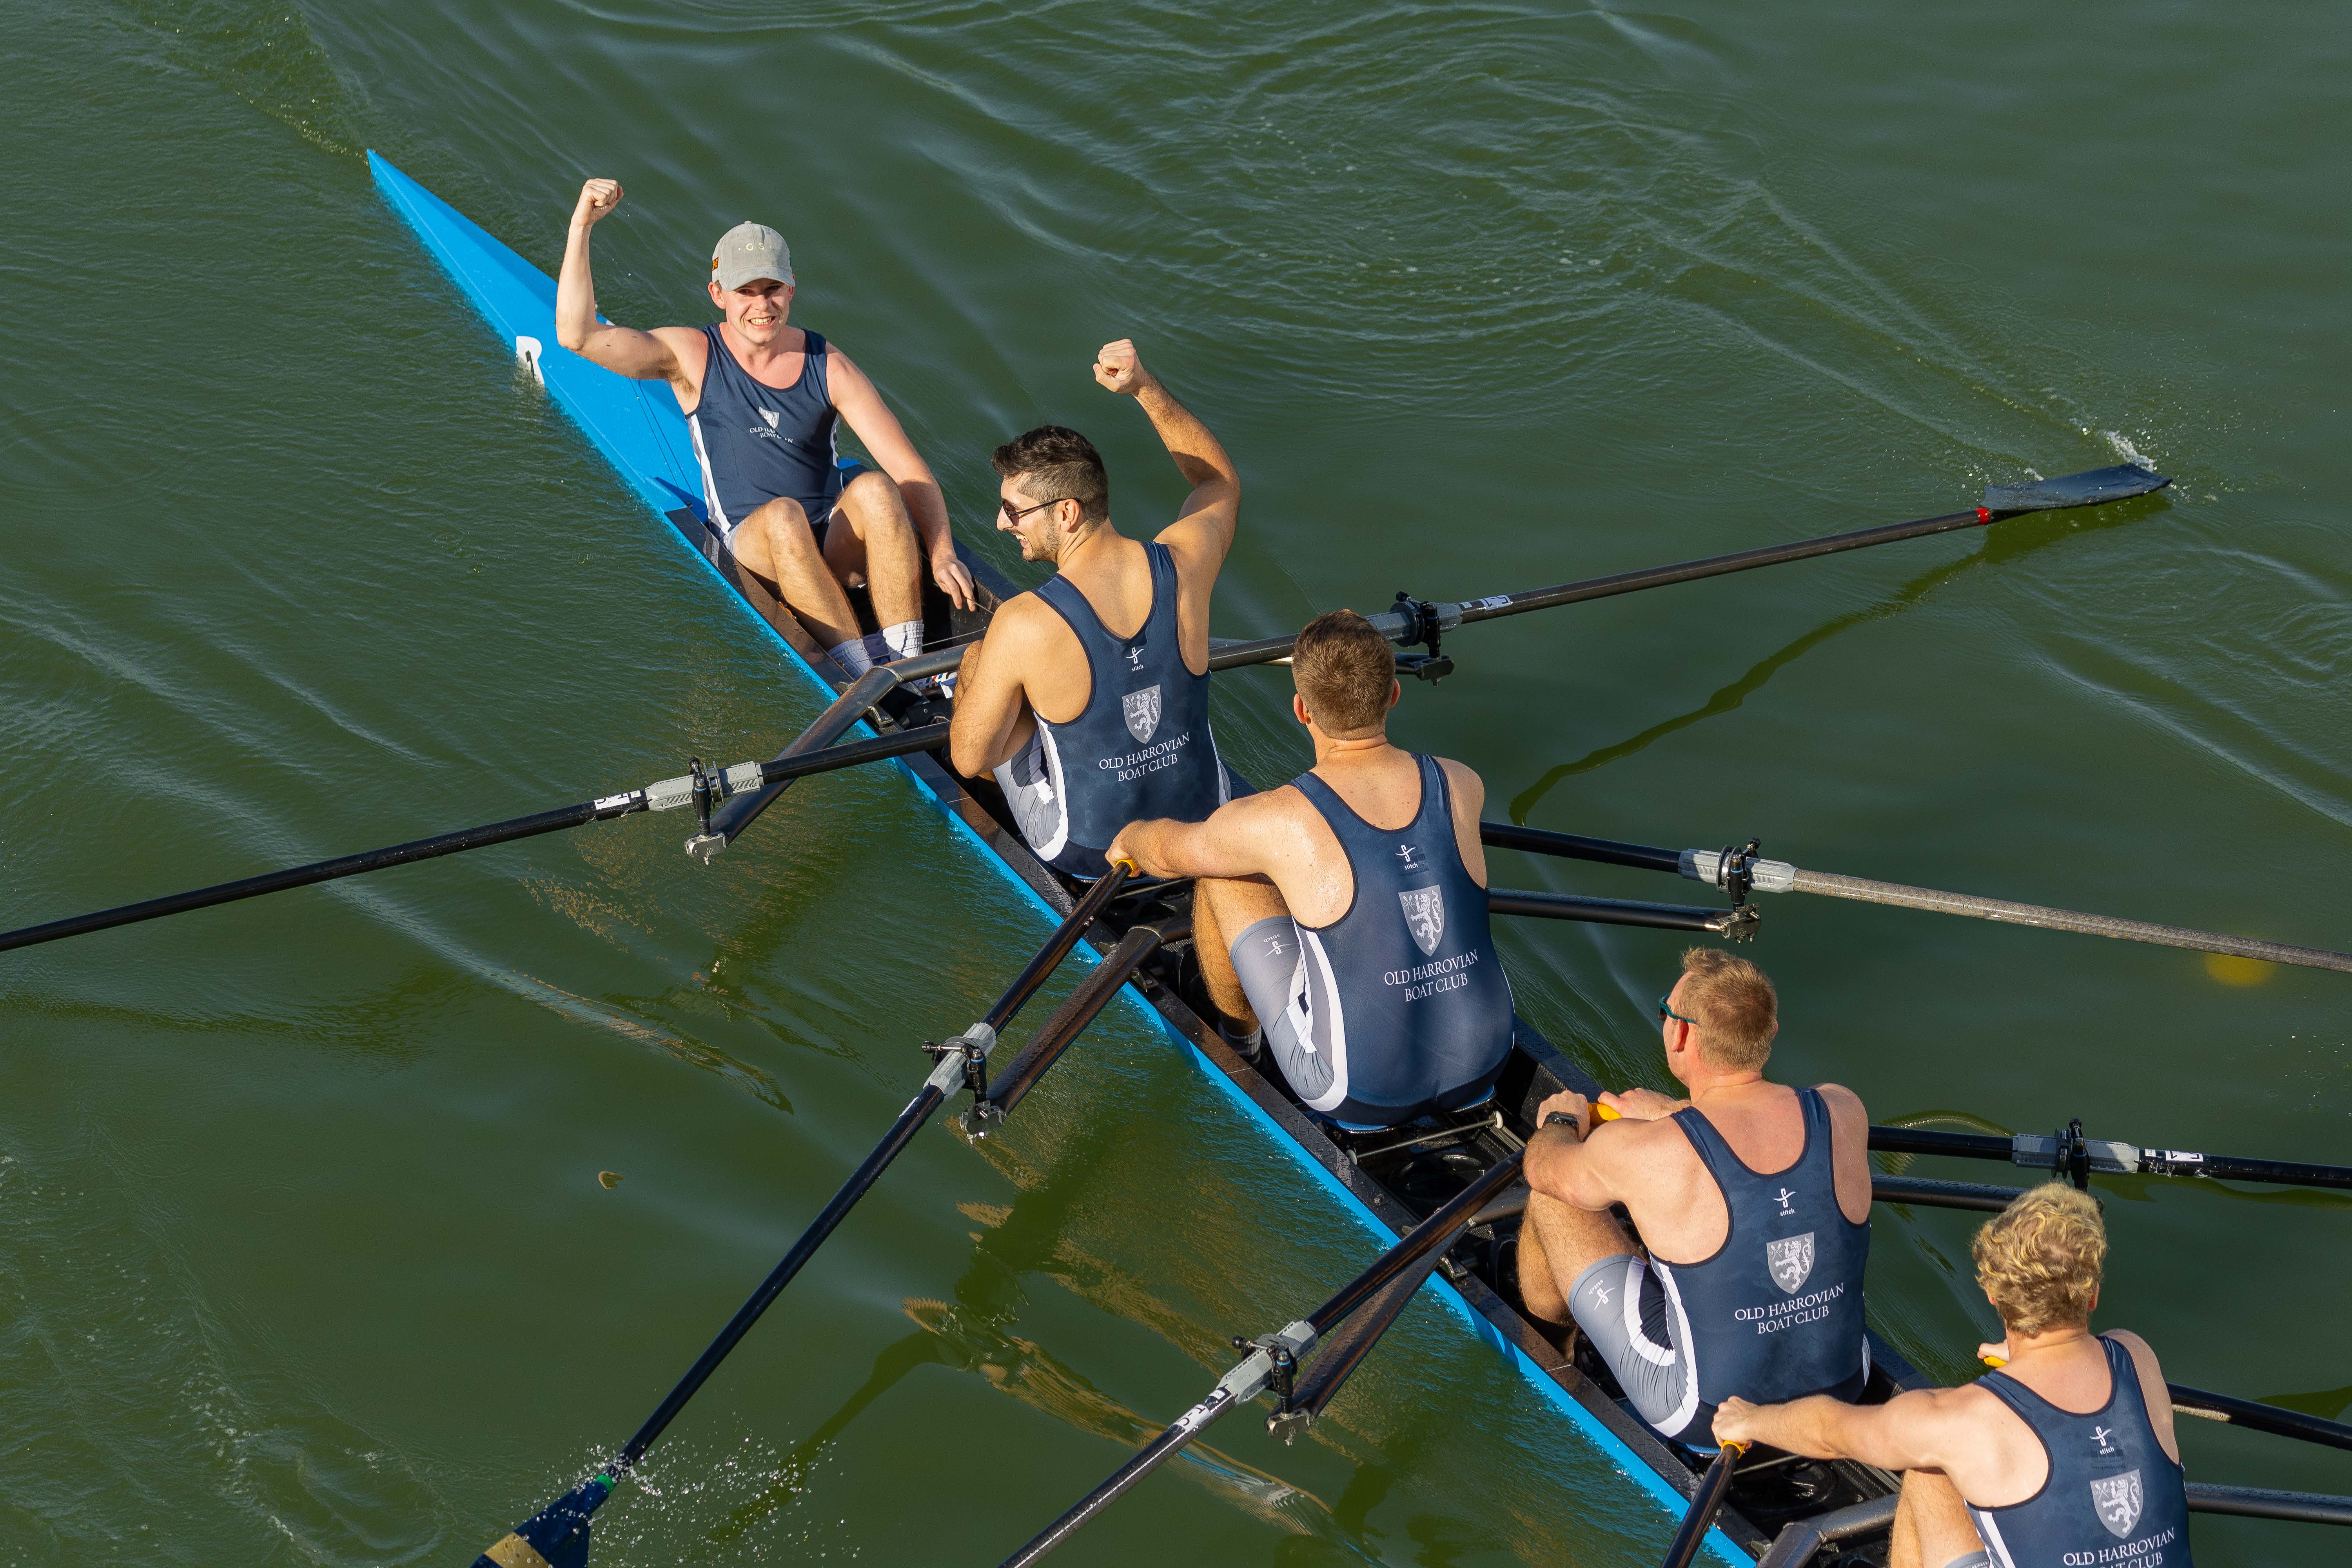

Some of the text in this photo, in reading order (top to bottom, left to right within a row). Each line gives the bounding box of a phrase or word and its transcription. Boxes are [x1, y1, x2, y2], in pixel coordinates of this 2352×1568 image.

[1099, 732, 1189, 769] OLD HARROVIAN
[1117, 754, 1178, 782] BOAT CLUB
[1263, 934, 1280, 943] stitch
[1384, 949, 1478, 985] OLD HARROVIAN
[1405, 973, 1468, 1002] BOAT CLUB
[1735, 1283, 1844, 1321] OLD HARROVIAN
[1758, 1306, 1829, 1335] BOAT CLUB
[2100, 1446, 2114, 1455] stitch
[2063, 1527, 2174, 1566] OLD HARROVIAN
[2128, 1552, 2163, 1568] CLUB
